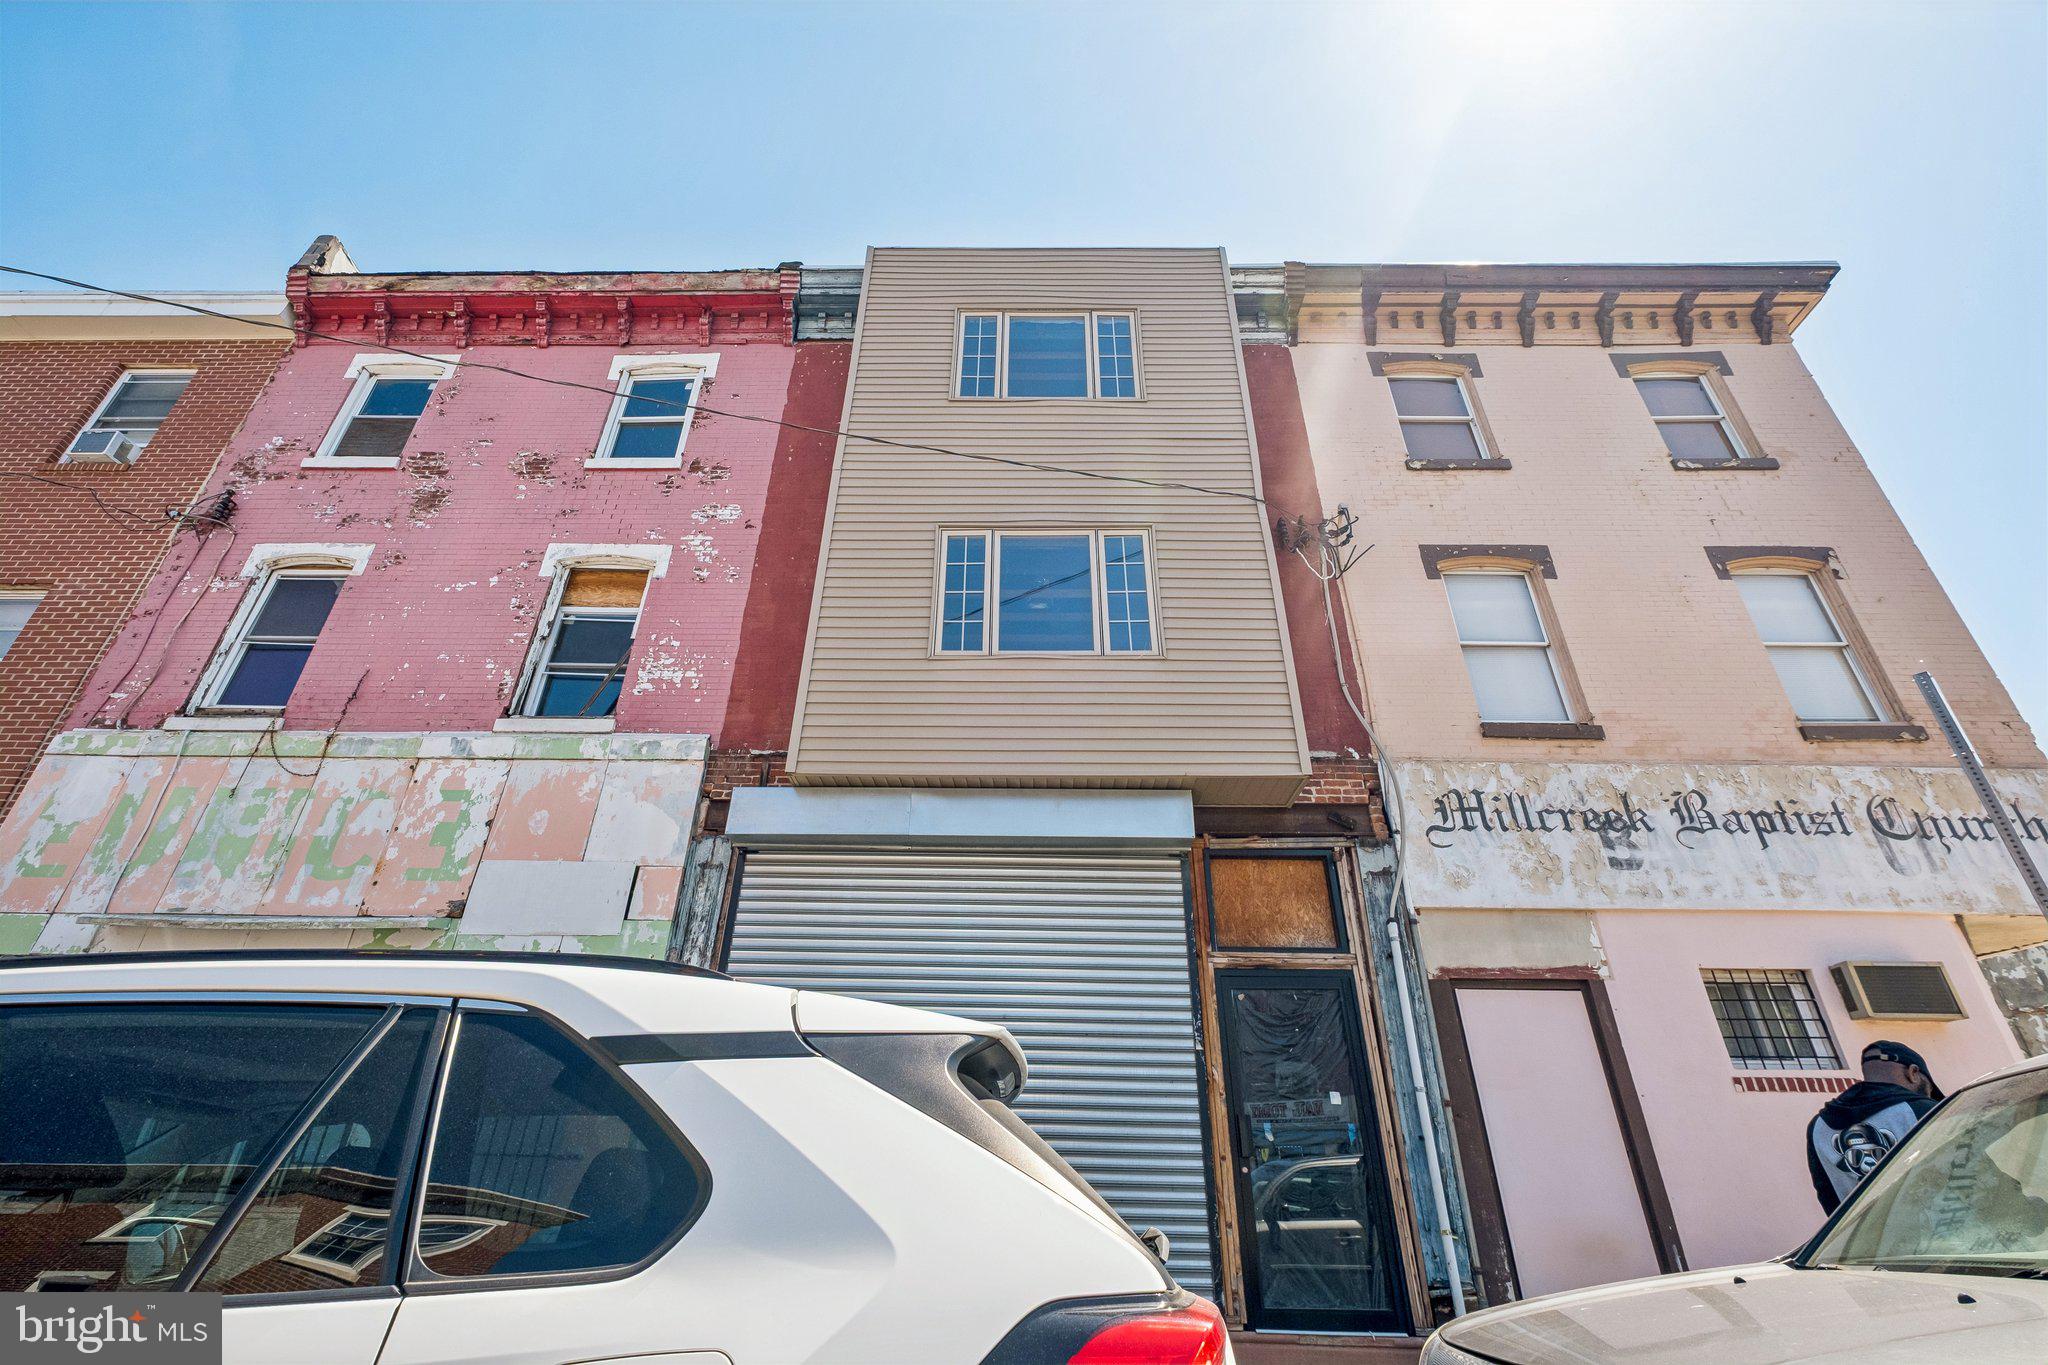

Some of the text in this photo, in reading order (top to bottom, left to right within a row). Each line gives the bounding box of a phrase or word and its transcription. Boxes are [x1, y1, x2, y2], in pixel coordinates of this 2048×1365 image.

[1426, 788, 2048, 854] Millcreek Baptist Churh
